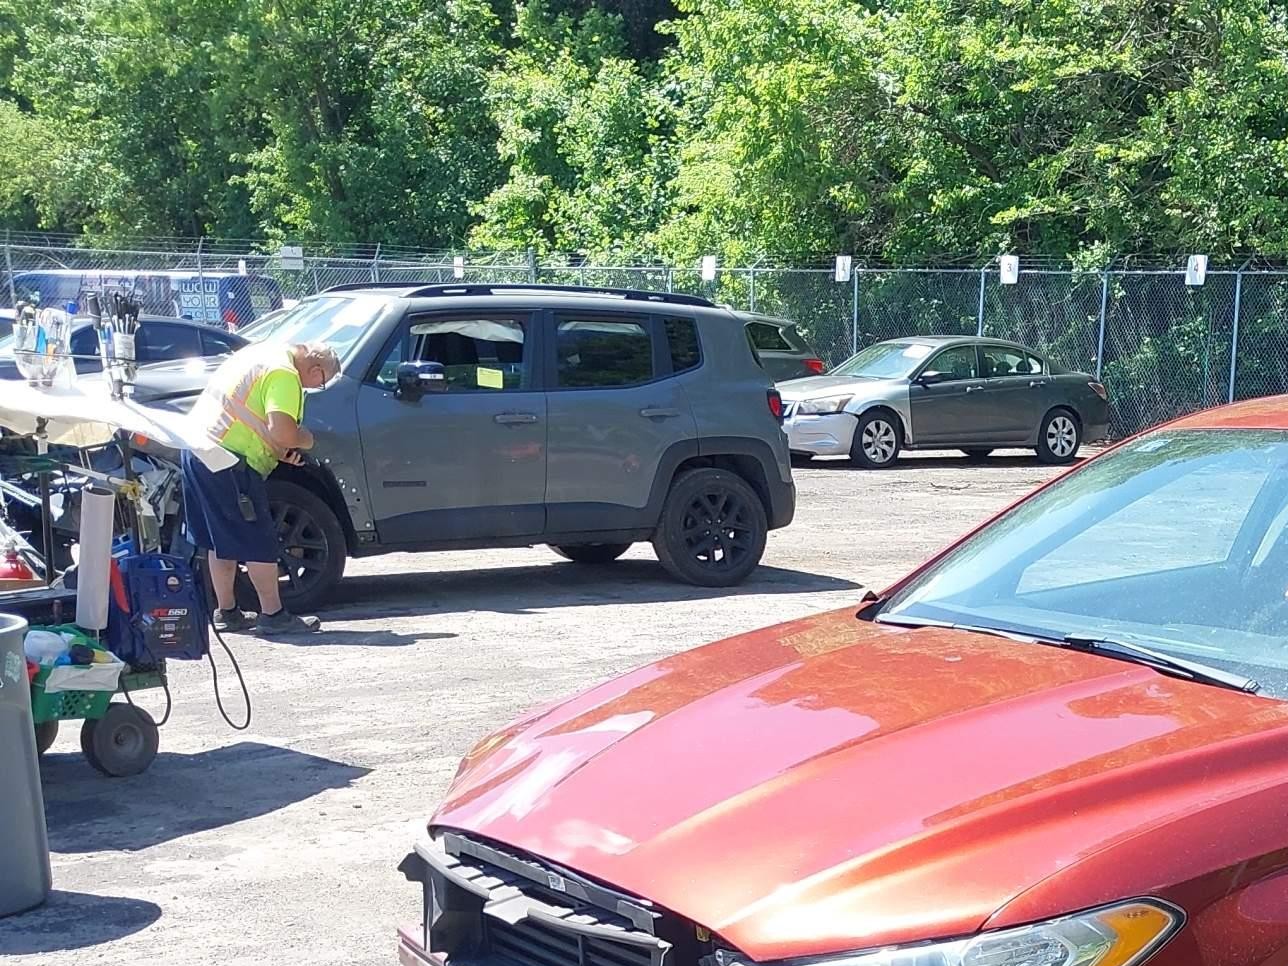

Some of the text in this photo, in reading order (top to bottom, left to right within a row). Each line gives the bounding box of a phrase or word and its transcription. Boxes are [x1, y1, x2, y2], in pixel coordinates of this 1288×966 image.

[1006, 263, 1012, 272] 3
[1194, 263, 1199, 273] 4
[182, 282, 216, 293] WOW
